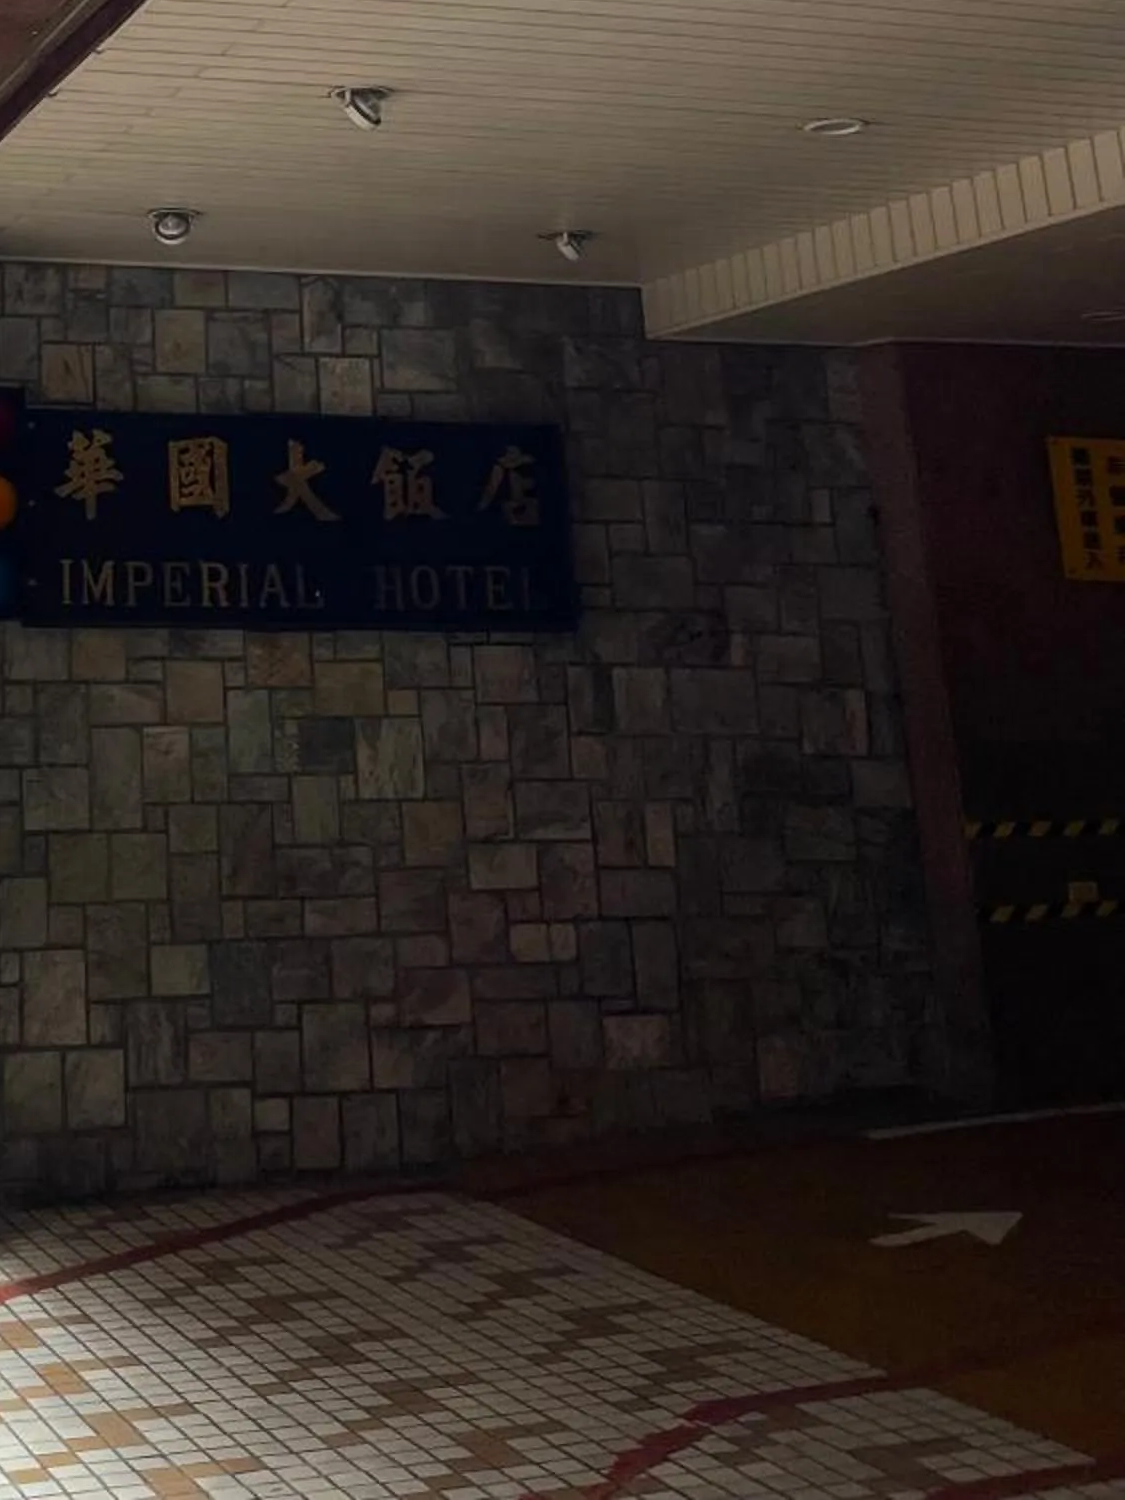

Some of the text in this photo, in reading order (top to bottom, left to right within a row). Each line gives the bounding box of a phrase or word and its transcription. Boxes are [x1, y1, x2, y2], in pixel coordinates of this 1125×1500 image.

[54, 429, 541, 525] 華國大飯店
[60, 557, 549, 613] IMPERIAL HOTEL
